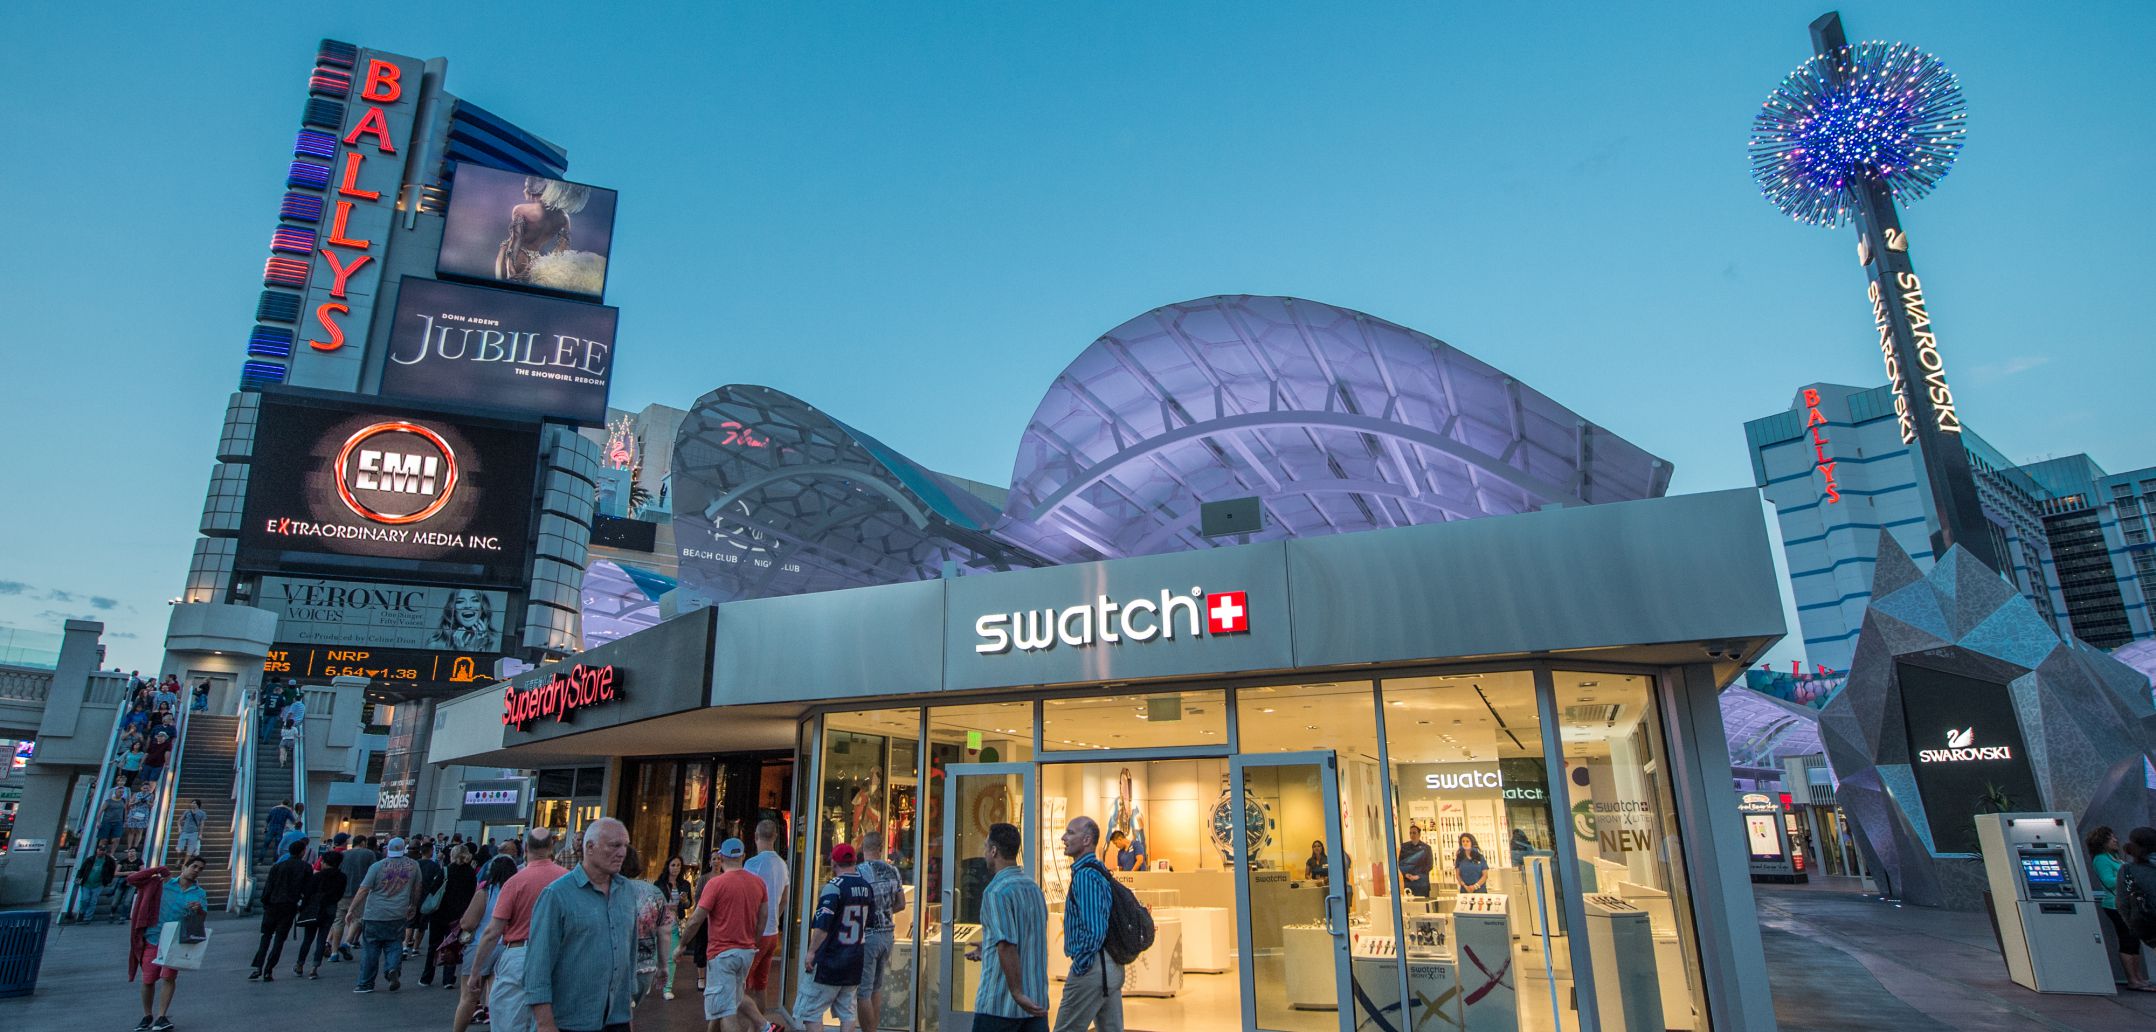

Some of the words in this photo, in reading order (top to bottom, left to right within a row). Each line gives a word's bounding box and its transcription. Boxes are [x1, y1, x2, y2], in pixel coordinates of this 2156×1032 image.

[441, 313, 466, 322] DONN
[467, 316, 500, 326] ARDEN'S
[390, 313, 609, 376] JUBILEE
[1897, 272, 1962, 434] SWAROVSKI
[1867, 280, 1919, 445] SWAROVSKI
[515, 368, 530, 376] THE
[531, 370, 573, 382] SHOWGIRL
[574, 376, 606, 386] REBORN
[355, 449, 438, 496] EMI
[267, 517, 409, 542] EXTRAORDINARY
[412, 532, 465, 547] MEDIA
[469, 536, 502, 550] INC.
[682, 548, 713, 560] BEACH
[715, 553, 738, 563] CLUB
[282, 580, 424, 613] VÉRONIC
[289, 607, 344, 622] VOICES
[379, 617, 397, 626] Fifty
[399, 618, 424, 627] Voices
[380, 610, 398, 619] One
[399, 612, 423, 621] Singer
[975, 588, 1201, 653] swatch
[355, 634, 364, 642] by
[368, 634, 394, 644] Celine
[396, 636, 416, 645] Dion
[327, 650, 370, 662] NRP
[1919, 746, 2012, 763] SWAROVSKI
[1595, 800, 1641, 813] swatch
[1600, 828, 1652, 853] NEW
[1255, 873, 1282, 883] swatch
[1410, 966, 1441, 974] swatch
